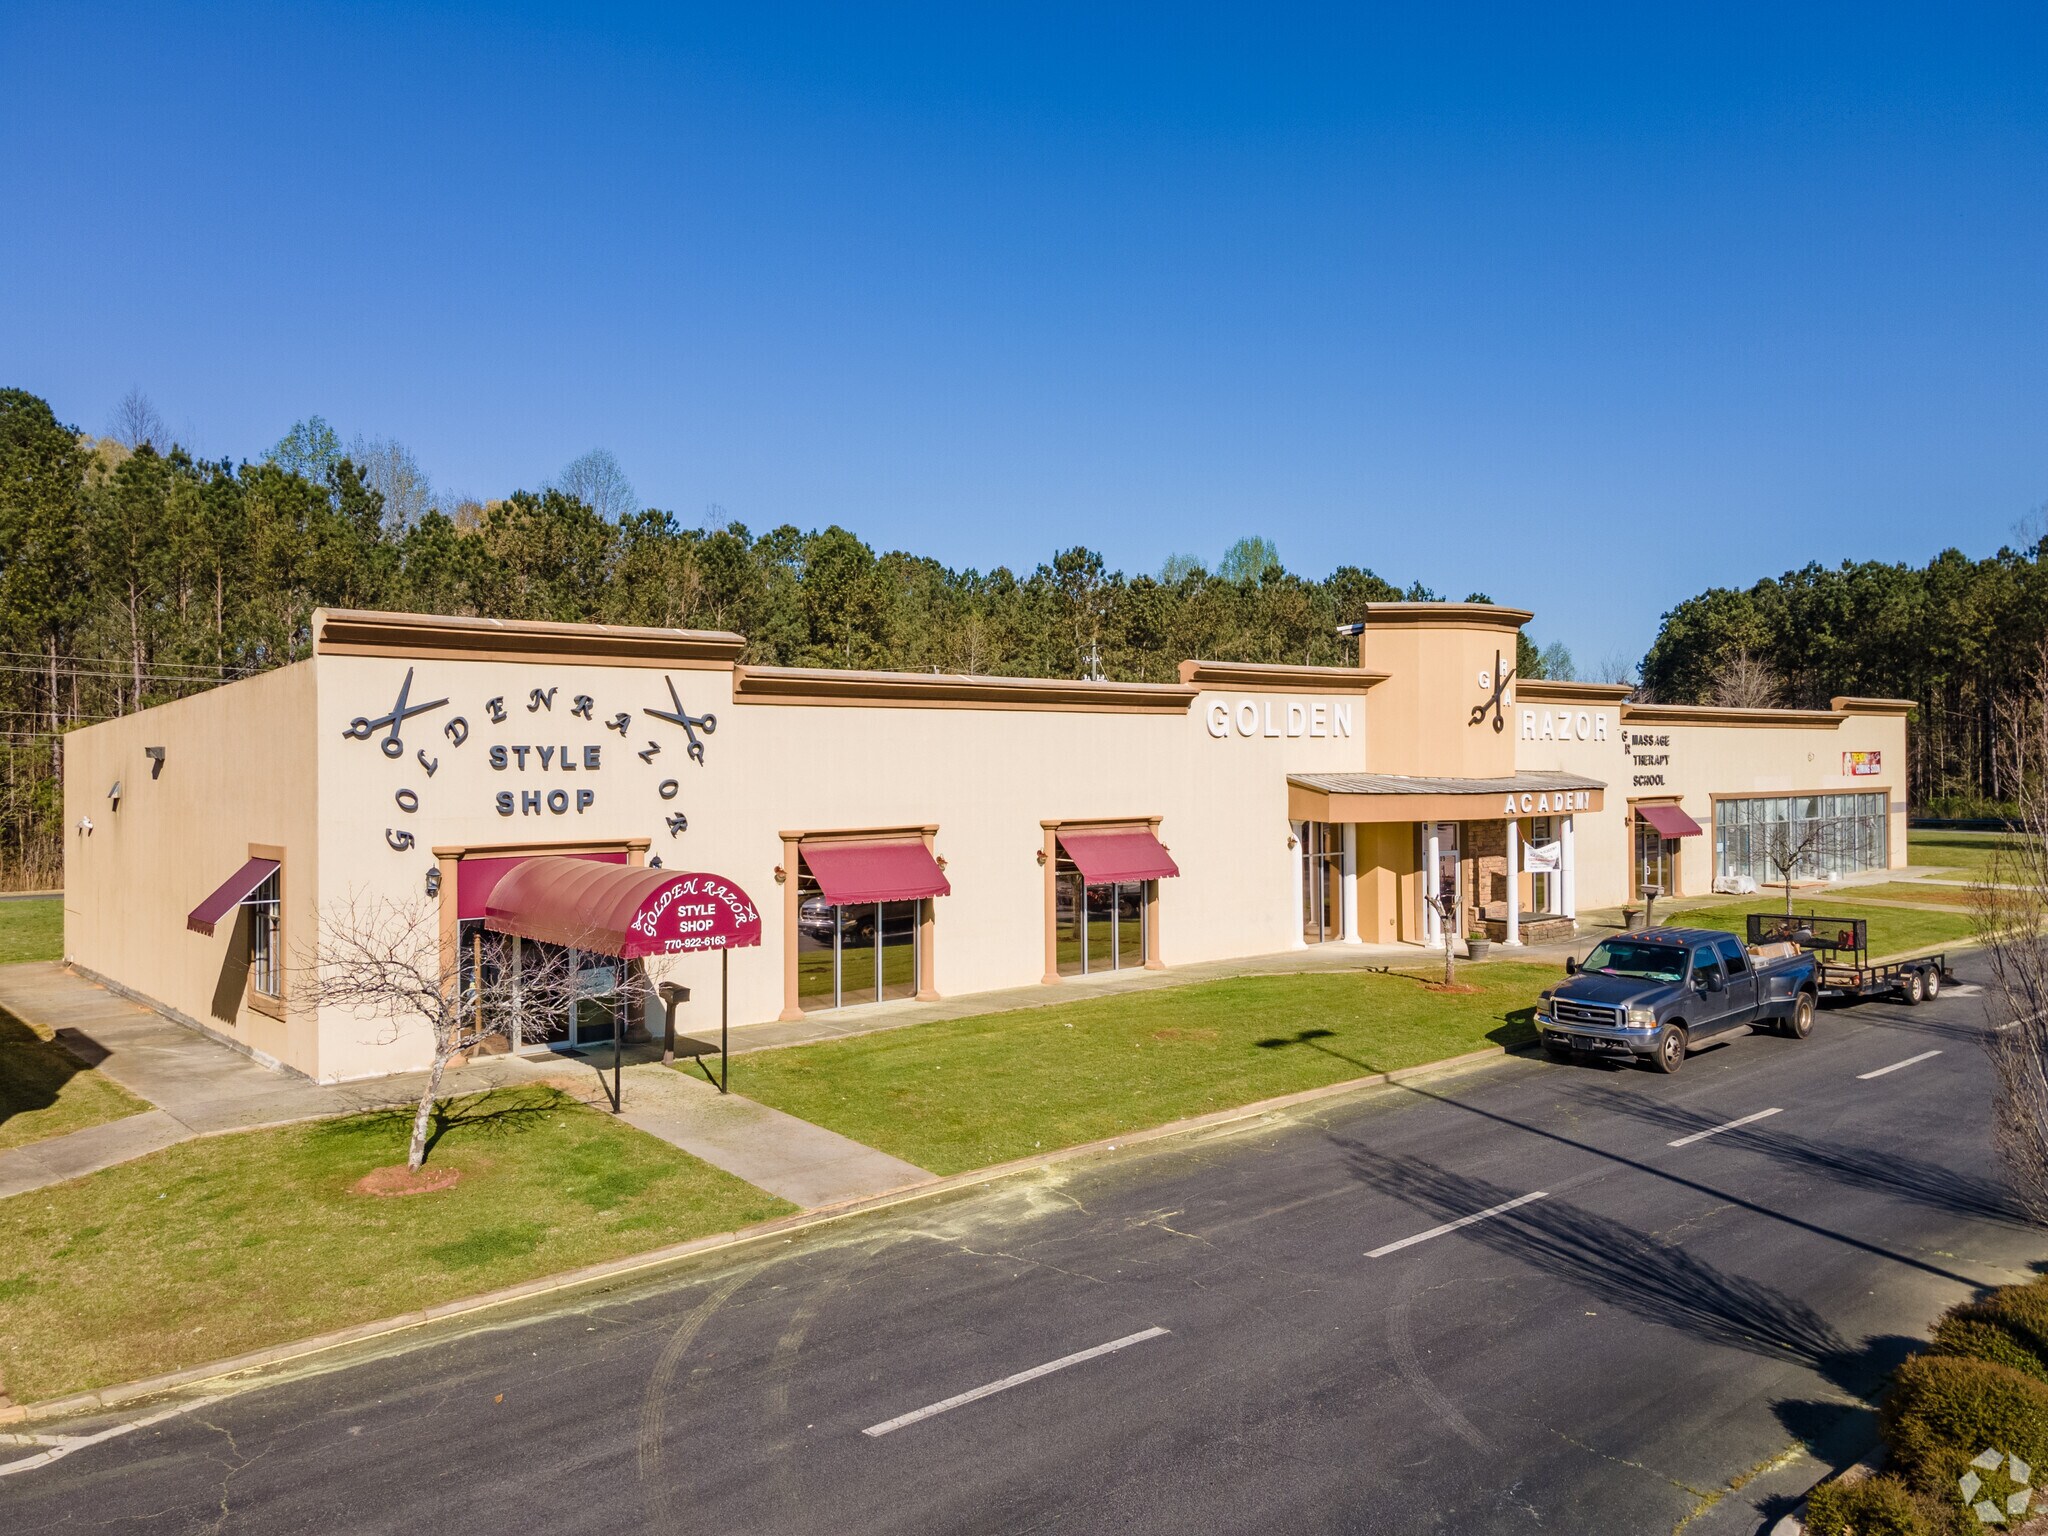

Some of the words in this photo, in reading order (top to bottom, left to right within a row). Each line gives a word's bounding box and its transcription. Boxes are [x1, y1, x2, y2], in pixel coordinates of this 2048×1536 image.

[1206, 700, 1352, 738] GOLDEN
[1521, 710, 1608, 741] RAZOR
[489, 744, 601, 772] STYLE
[1632, 754, 1670, 766] THERAPY
[1632, 774, 1665, 787] SCHOOL
[496, 788, 595, 815] SHOP
[1504, 791, 1590, 814] ACADEMY
[643, 878, 698, 937] GOLDEN
[702, 881, 747, 928] RAZOR
[677, 904, 716, 917] STYLE
[679, 919, 714, 933] SHOP
[664, 935, 727, 950] 770-922-6163
